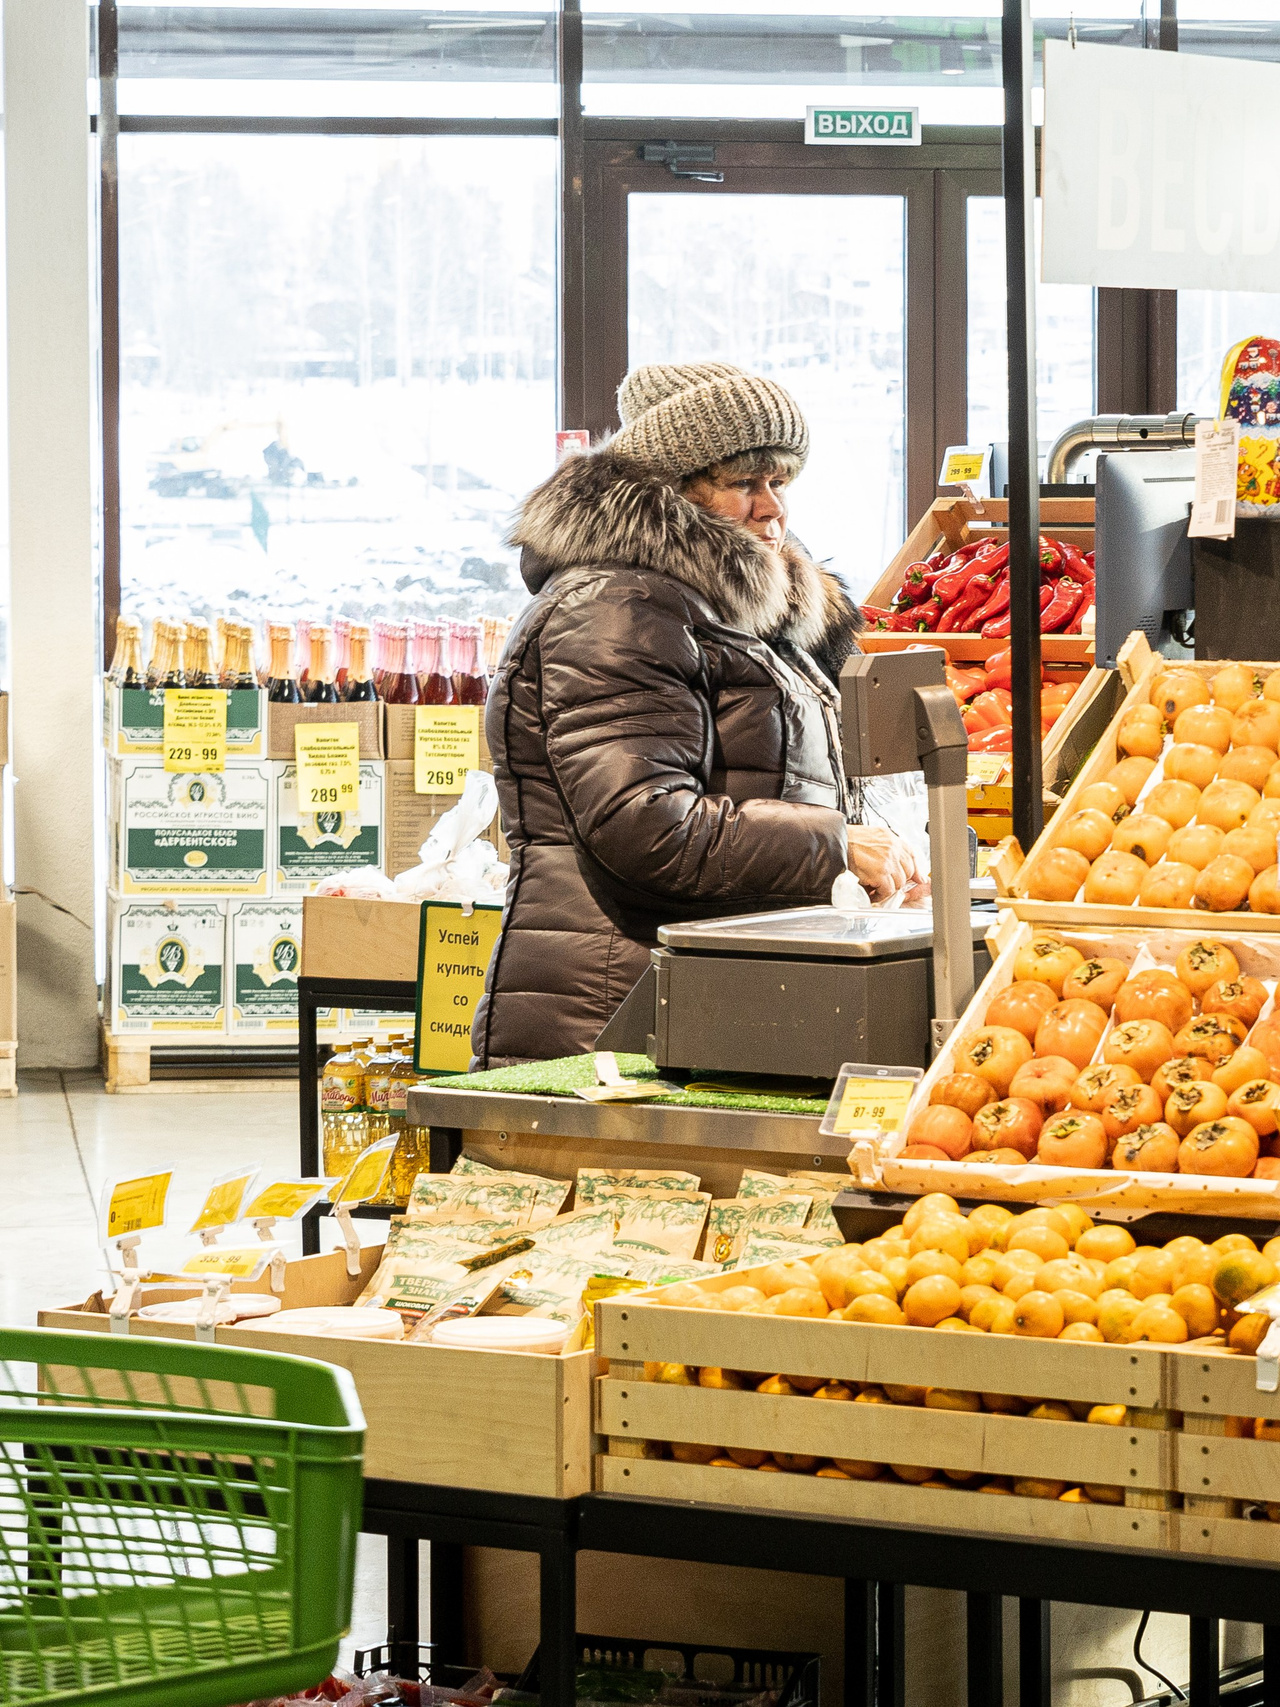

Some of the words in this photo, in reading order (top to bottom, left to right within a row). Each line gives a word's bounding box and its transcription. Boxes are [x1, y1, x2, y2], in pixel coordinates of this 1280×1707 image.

[818, 114, 908, 136] ВЫХОД
[169, 748, 191, 760] 229
[202, 748, 217, 760] 99
[427, 771, 454, 785] 269
[311, 788, 338, 802] 289
[341, 784, 353, 793] 99
[135, 811, 191, 819] РОССИЙСКОЕ
[155, 829, 212, 837] ПОЛУСЛАДКОЕ
[213, 829, 237, 837] БЕЛОЕ
[154, 837, 238, 847] «ДЕРБЕНТСКОЕ»
[438, 929, 479, 946] Успей
[436, 962, 484, 978] купить
[453, 994, 468, 1006] со
[430, 1021, 471, 1038] скидк
[853, 1106, 866, 1117] 87
[871, 1106, 885, 1117] 99
[406, 1287, 438, 1297] ЗНАК
